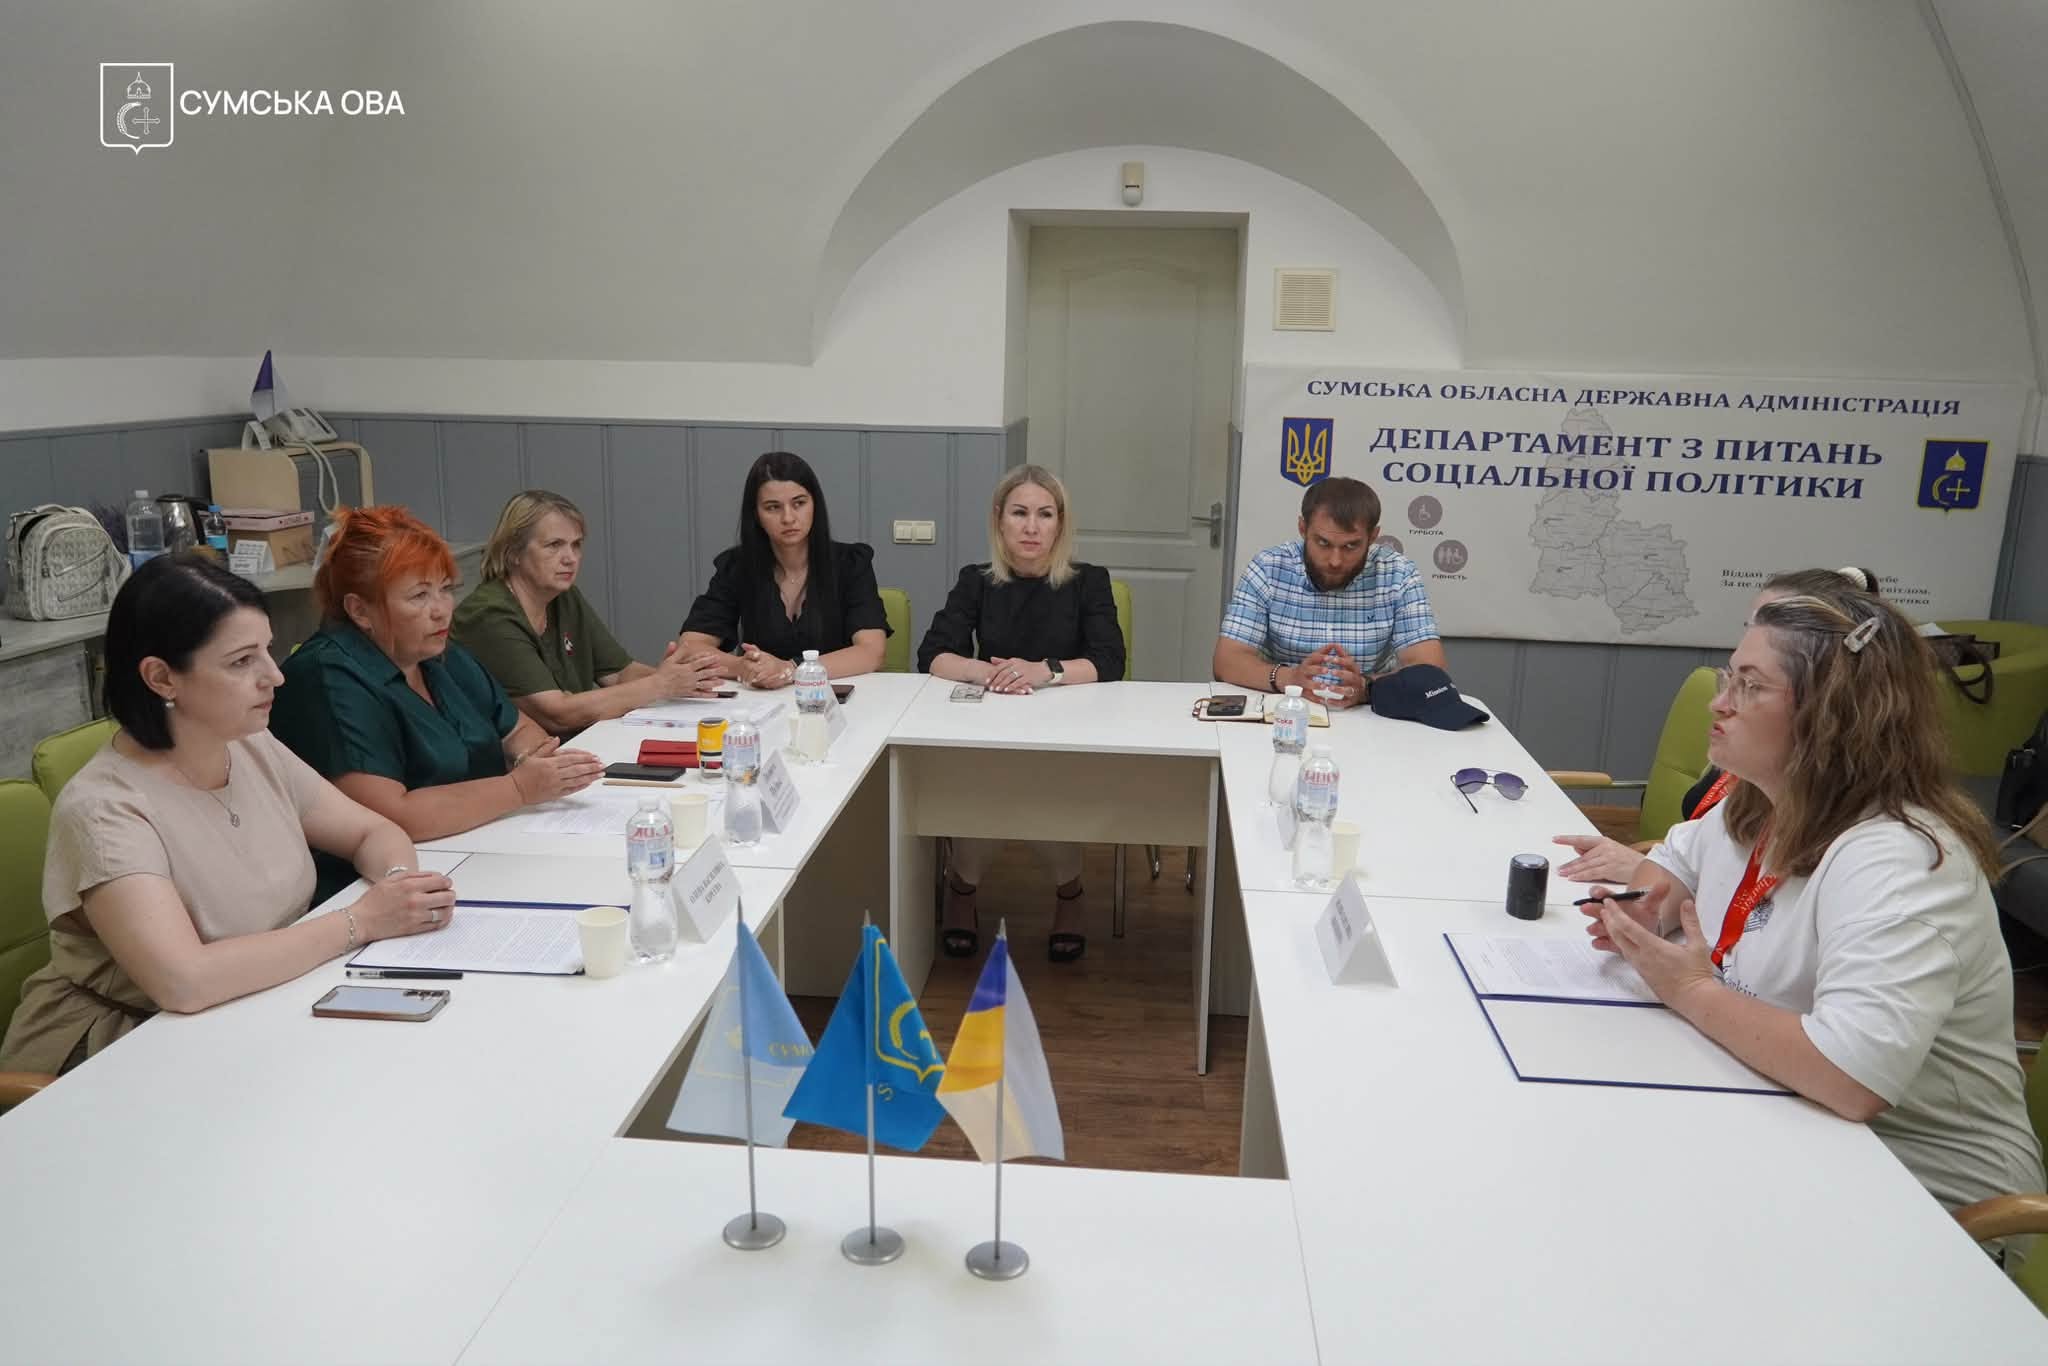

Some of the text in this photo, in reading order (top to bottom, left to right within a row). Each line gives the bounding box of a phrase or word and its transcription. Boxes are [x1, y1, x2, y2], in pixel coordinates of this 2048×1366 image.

[1306, 380, 1961, 417] СУМСЬКА ОБЛАСНА ДЕРЖАВНА АДМІНІСТРАЦІЯ
[1369, 427, 1883, 466] ДЕПАРТАМЕНТ З ПИТАНЬ
[1382, 461, 1865, 499] СОЦІАЛЬНОЇ ПОЛІТИКИ
